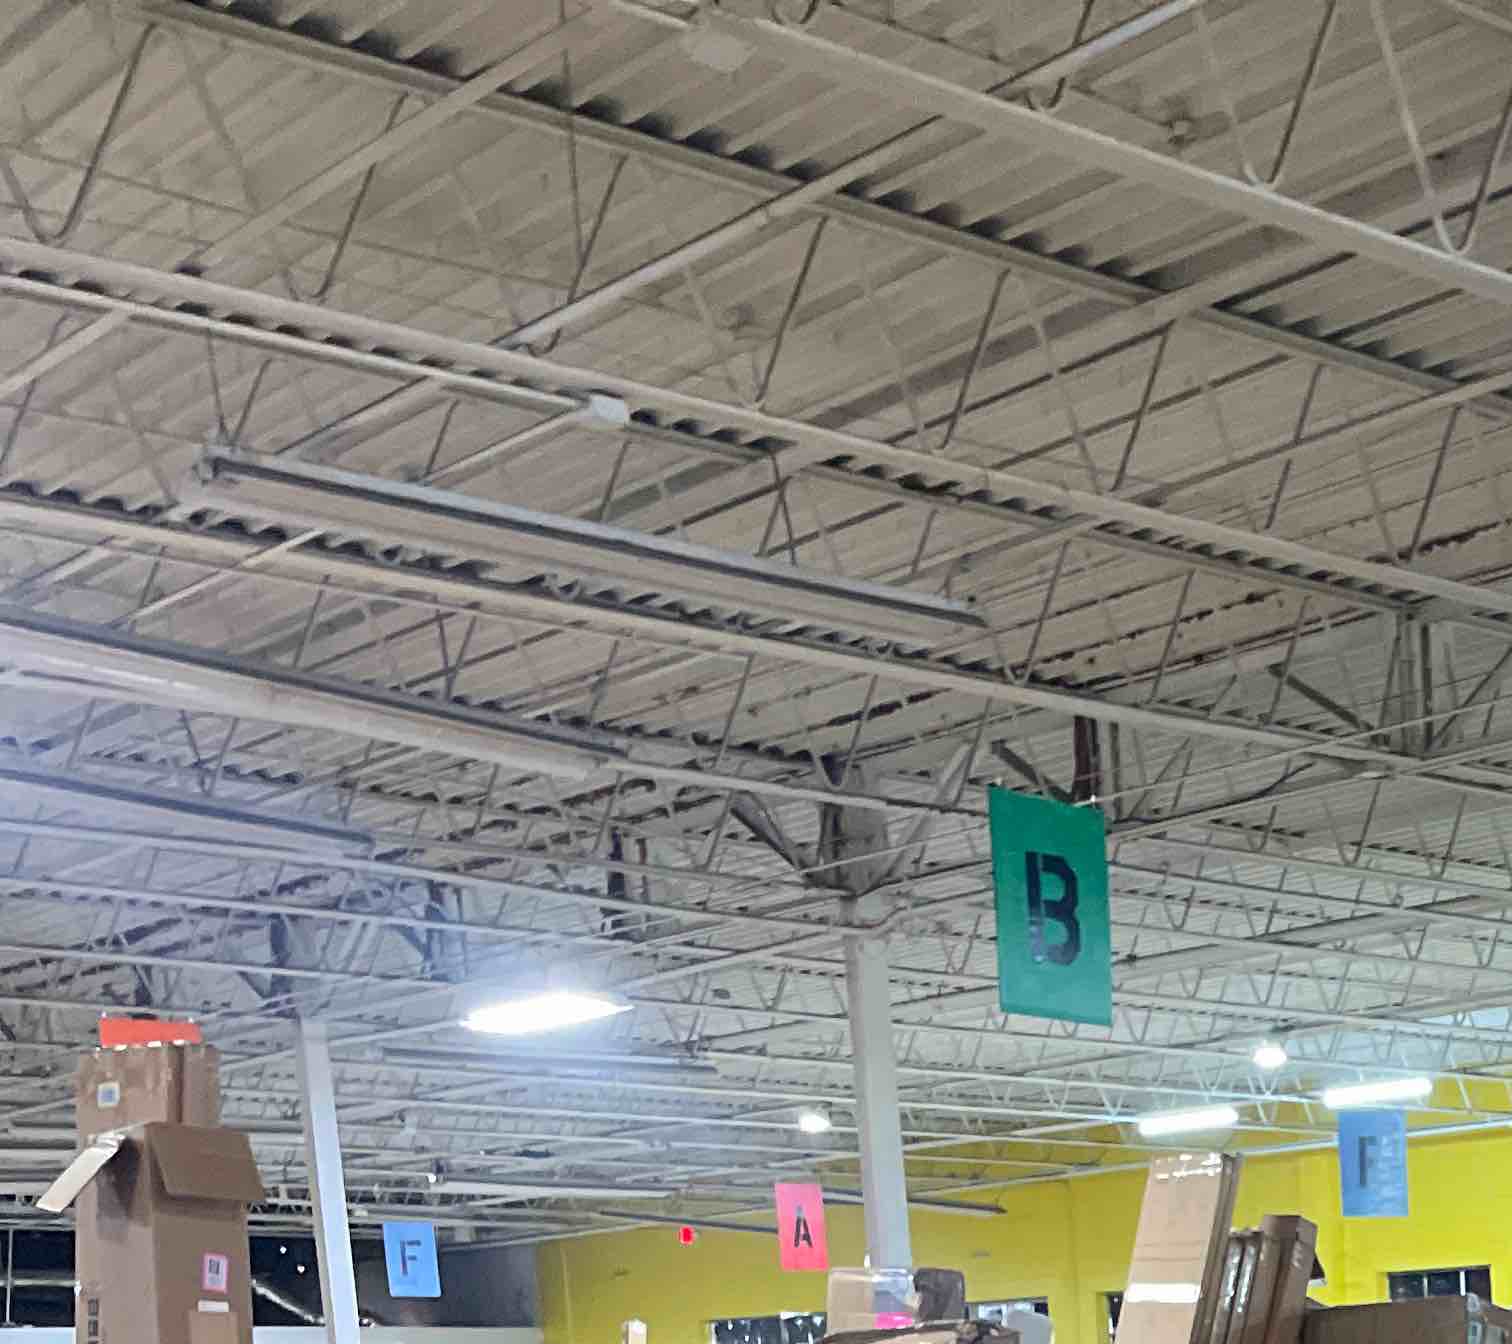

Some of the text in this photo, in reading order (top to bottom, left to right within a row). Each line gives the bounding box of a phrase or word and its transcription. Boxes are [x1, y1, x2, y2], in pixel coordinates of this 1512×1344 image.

[1024, 851, 1082, 967] B
[792, 1204, 814, 1249] A
[399, 1239, 423, 1277] F
